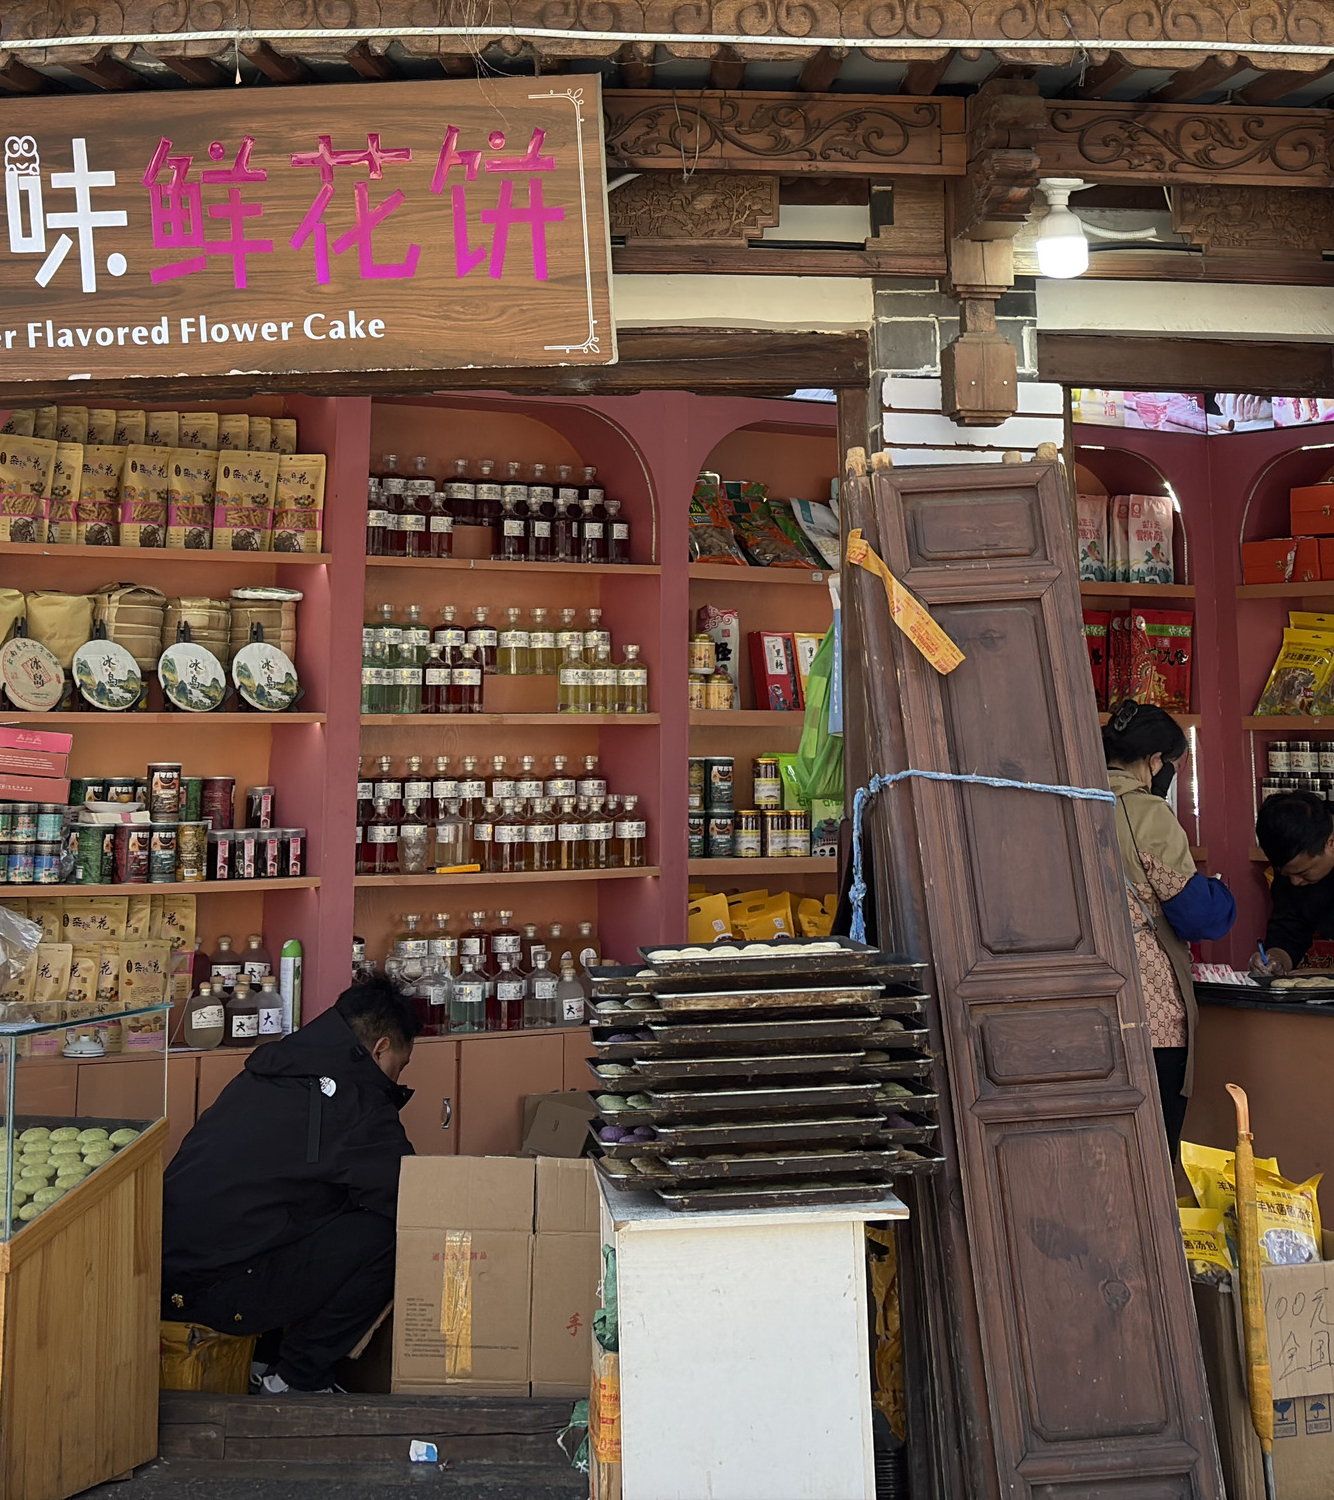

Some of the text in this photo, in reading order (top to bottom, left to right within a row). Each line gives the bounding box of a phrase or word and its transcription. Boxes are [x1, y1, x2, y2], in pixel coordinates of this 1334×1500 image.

[28, 316, 171, 348] Flavored
[179, 315, 299, 344] Flower
[304, 312, 386, 341] Cake
